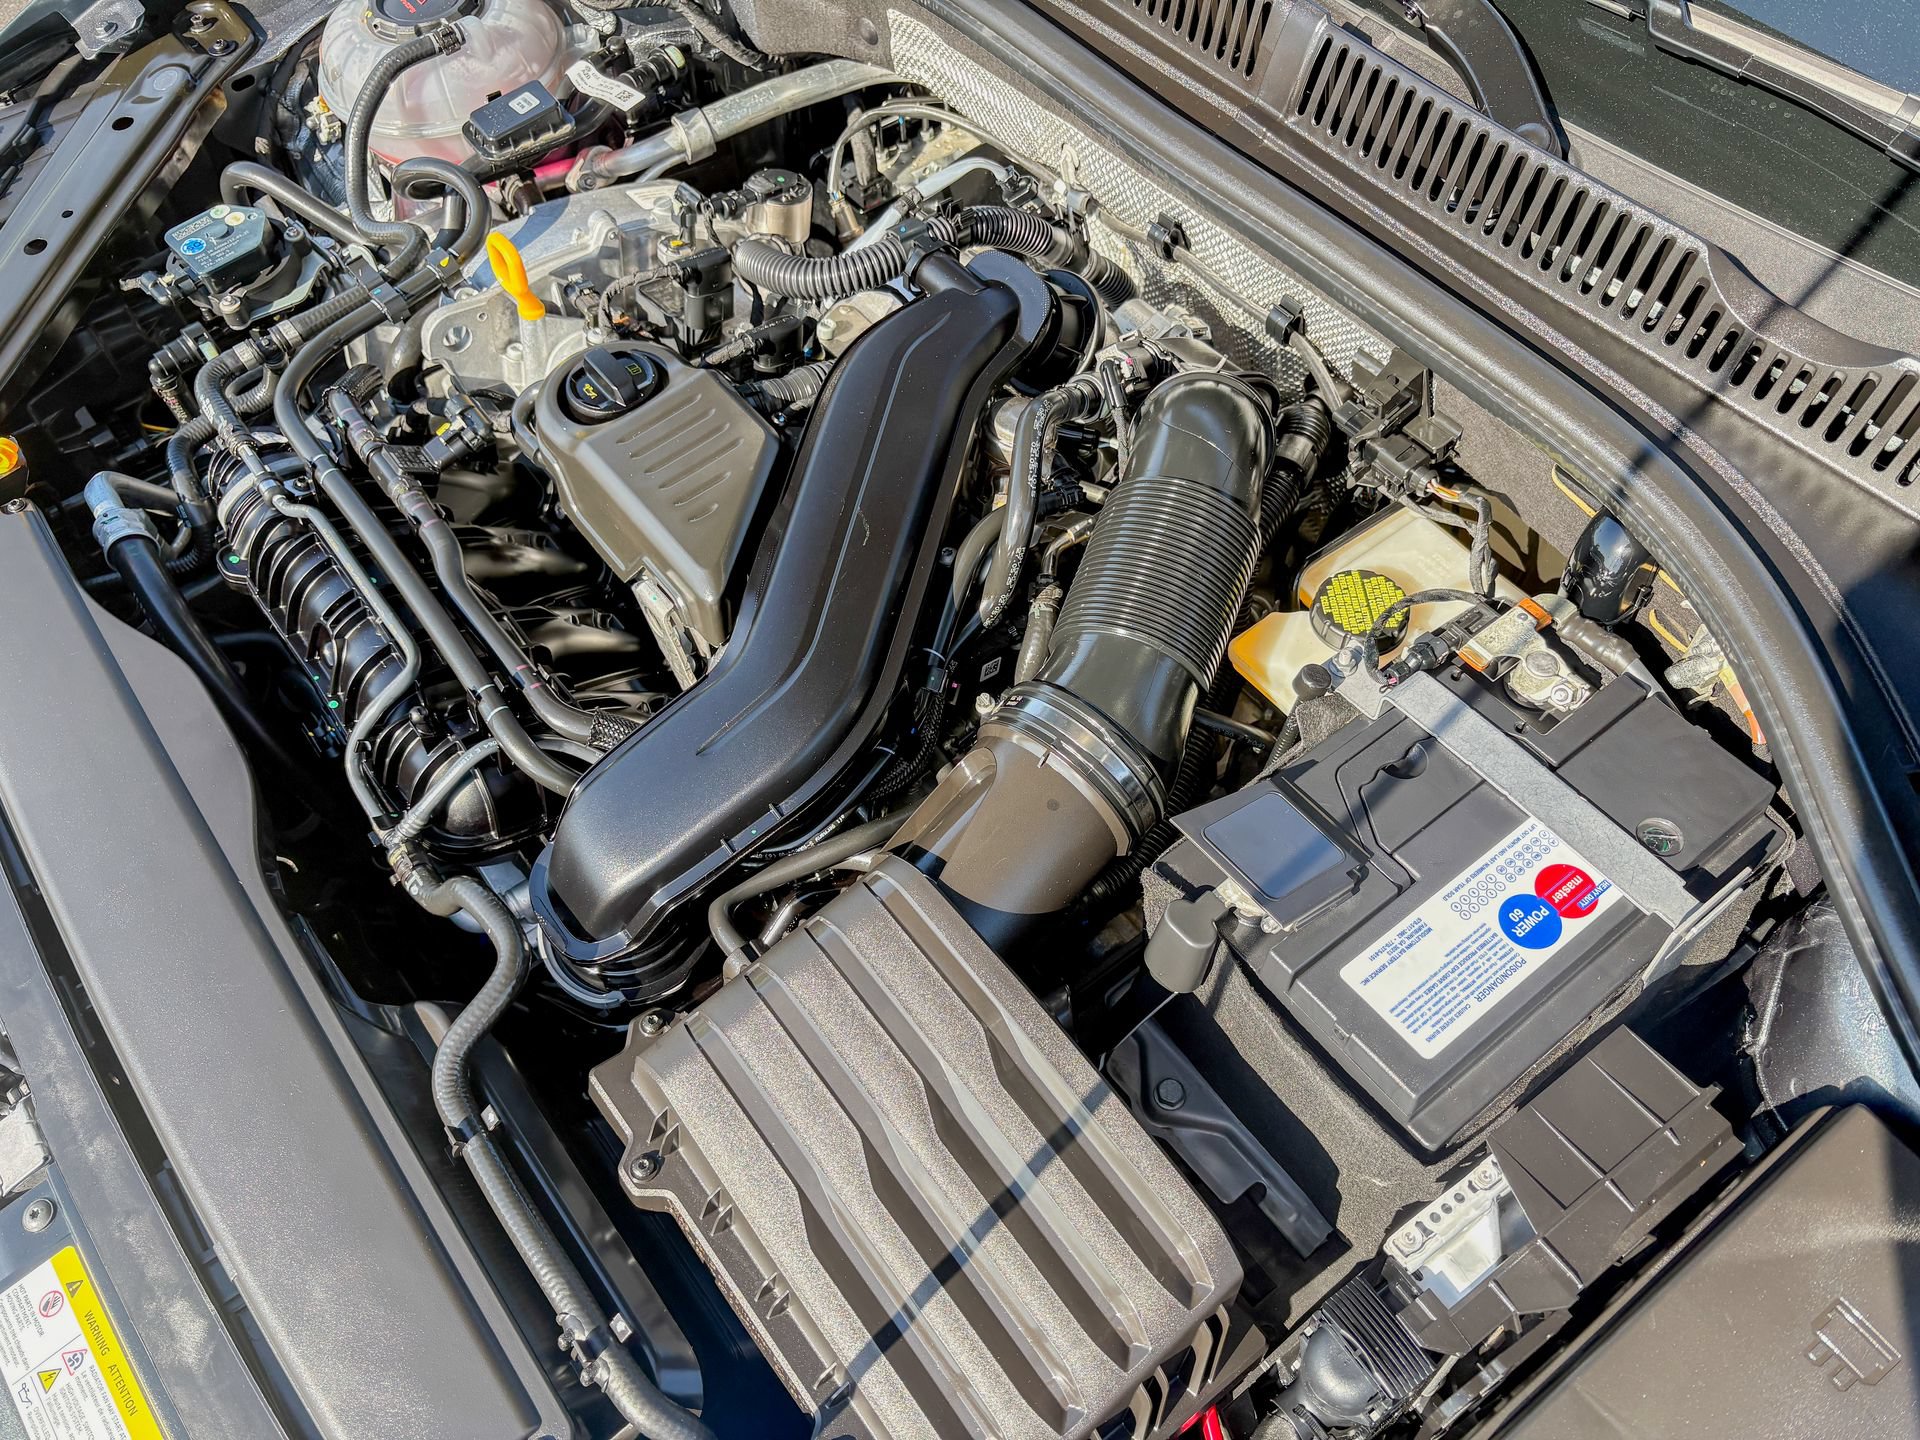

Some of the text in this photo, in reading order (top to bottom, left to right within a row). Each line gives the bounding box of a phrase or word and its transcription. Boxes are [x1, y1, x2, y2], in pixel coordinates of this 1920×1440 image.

[1549, 874, 1585, 904] master
[1577, 879, 1611, 908] HEAVY DUTY
[1507, 907, 1525, 923] 60
[1510, 904, 1550, 938] POWER
[1456, 948, 1478, 967] PRODUCE
[1436, 964, 1460, 984] EXPLOSIVE
[1472, 956, 1527, 1003] POISON/DANGER
[83, 1309, 110, 1356] WARNING
[106, 1361, 138, 1417] ATTENTION
